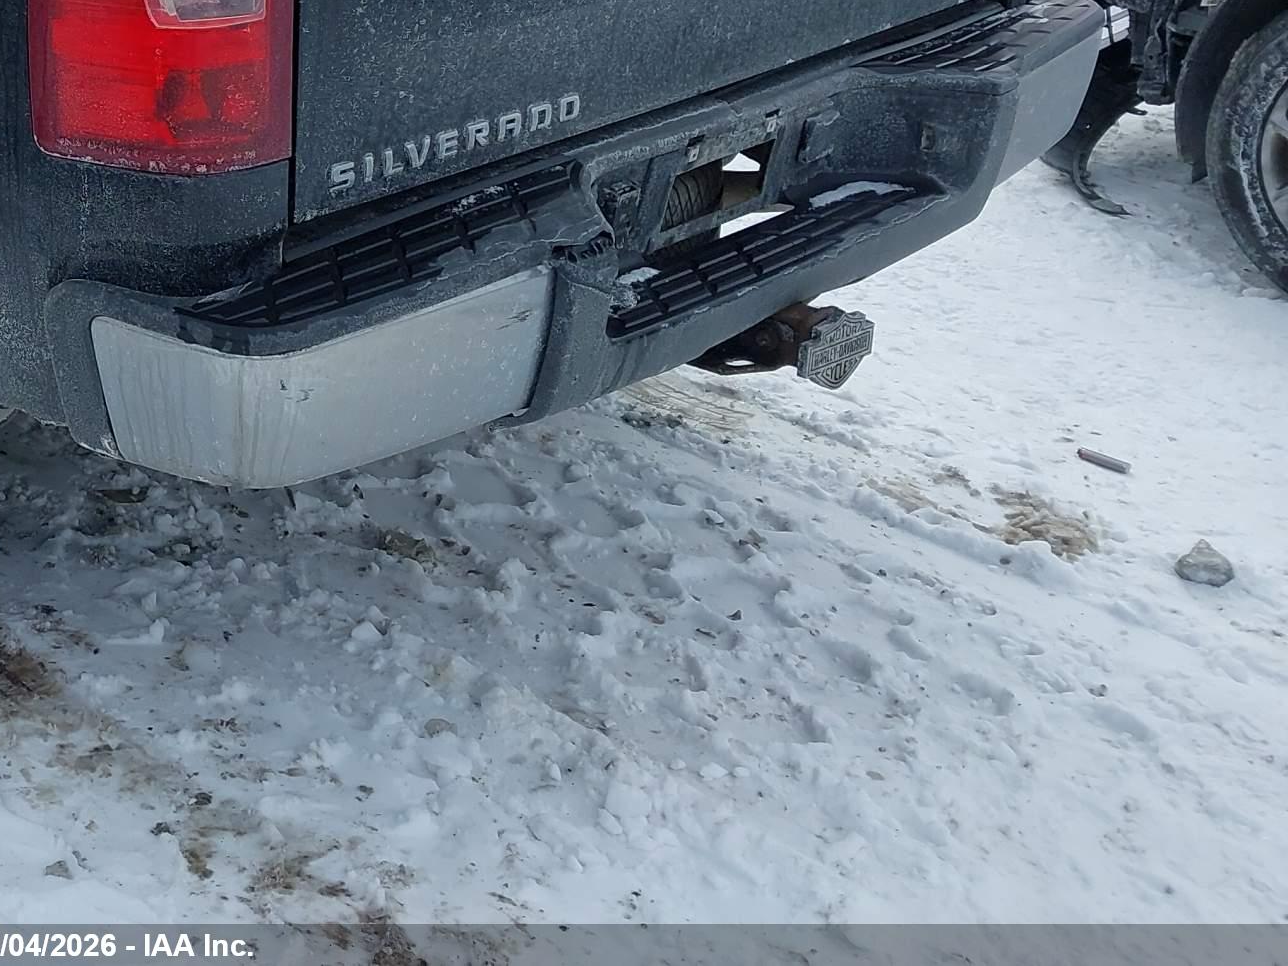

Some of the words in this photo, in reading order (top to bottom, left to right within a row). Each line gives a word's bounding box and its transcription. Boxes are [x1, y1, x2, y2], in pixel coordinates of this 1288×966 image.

[329, 94, 581, 195] SILVERADO
[825, 320, 863, 345] MOTOR
[813, 334, 869, 369] HARLEY-DAVIDSON
[822, 355, 859, 381] CYCLES
